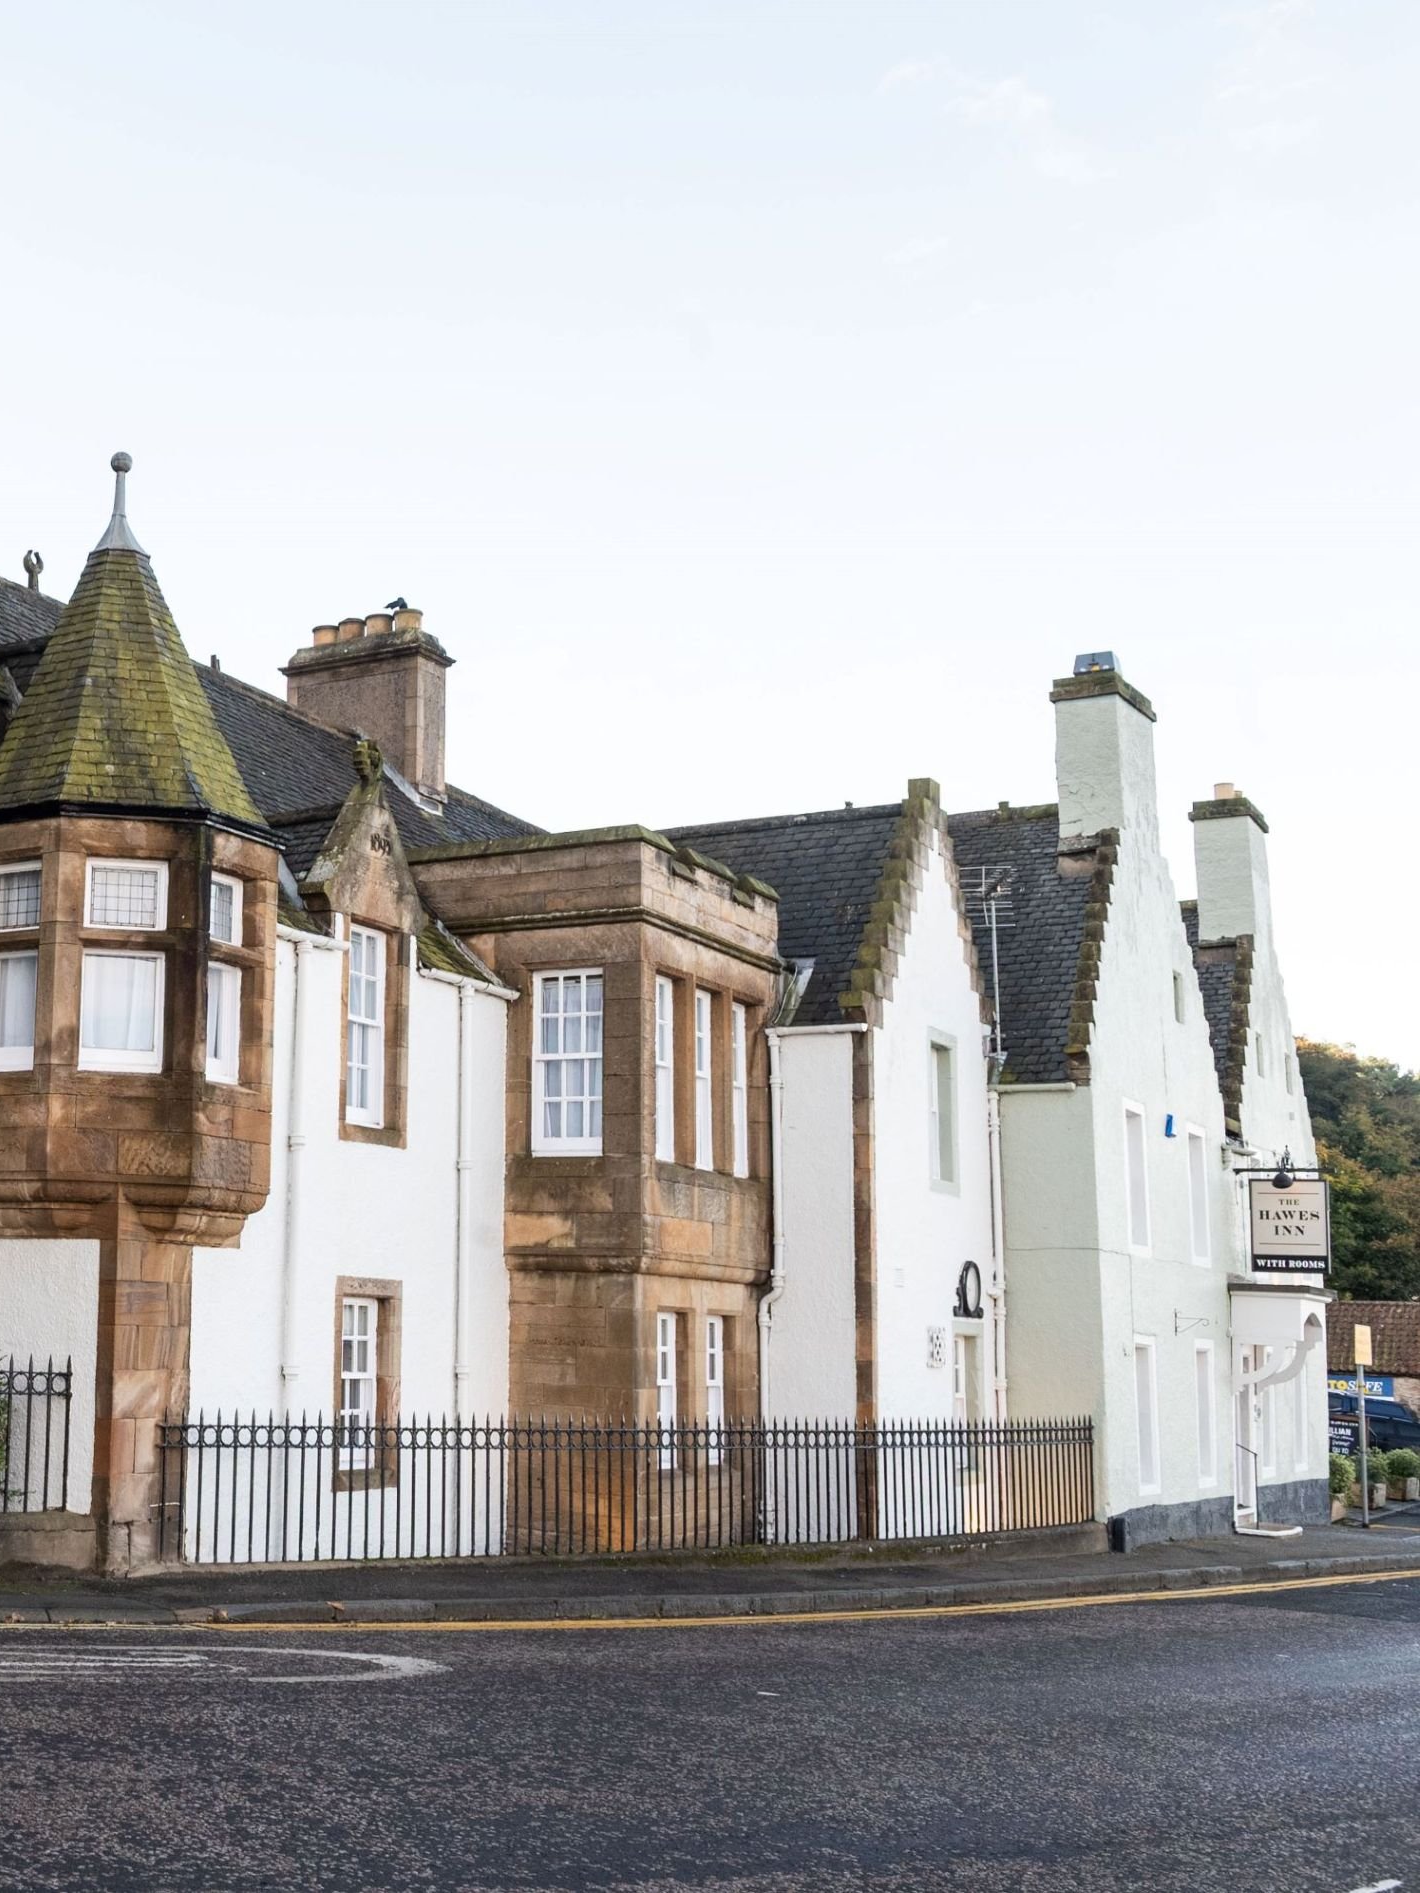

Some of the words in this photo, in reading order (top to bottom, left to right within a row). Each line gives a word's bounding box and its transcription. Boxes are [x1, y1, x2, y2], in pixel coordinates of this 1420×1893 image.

[1259, 1210, 1320, 1220] HAWES
[1274, 1225, 1305, 1236] INN
[1256, 1259, 1286, 1267] WITH
[1288, 1260, 1326, 1268] ROOMS
